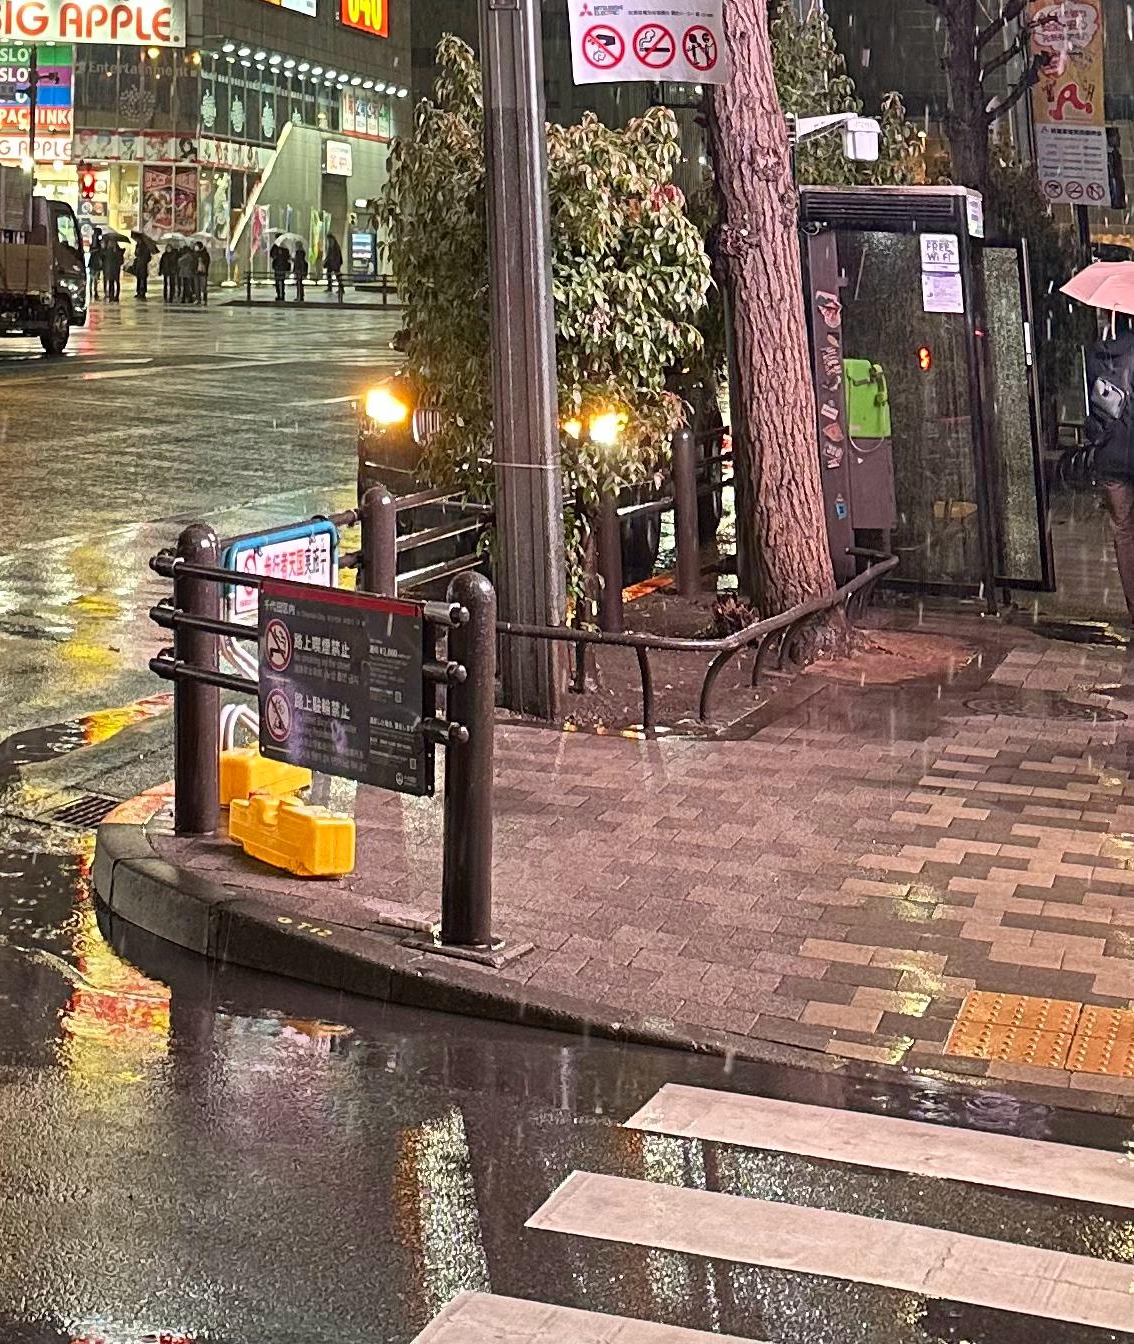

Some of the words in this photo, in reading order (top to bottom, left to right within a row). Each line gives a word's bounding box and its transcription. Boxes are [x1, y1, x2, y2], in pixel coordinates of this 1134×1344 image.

[0, 47, 32, 63] SLO
[926, 241, 951, 252] FREE
[293, 631, 351, 659] 路上喫煙禁止
